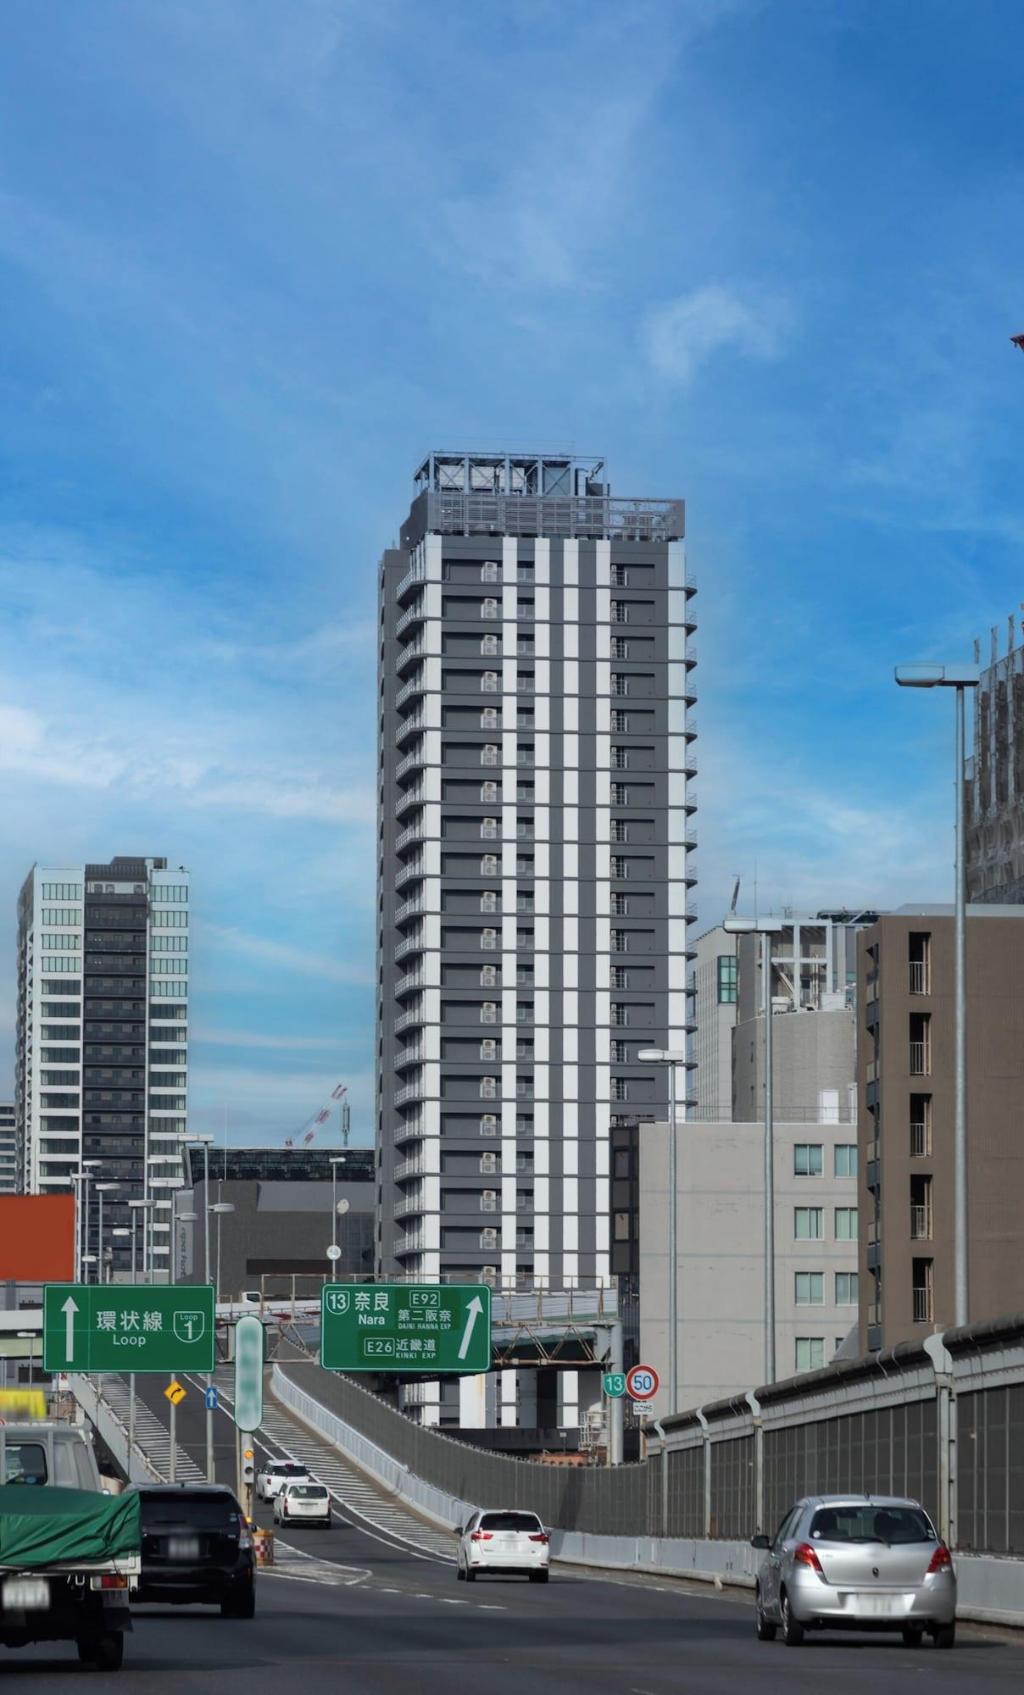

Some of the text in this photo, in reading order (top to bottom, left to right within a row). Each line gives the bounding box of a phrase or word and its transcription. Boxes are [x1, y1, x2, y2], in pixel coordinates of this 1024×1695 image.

[329, 1293, 347, 1310] 13
[354, 1291, 390, 1312] 奈良
[412, 1293, 438, 1305] E92
[96, 1310, 163, 1332] 環状線
[179, 1314, 199, 1322] Loop
[358, 1314, 386, 1326] Nara
[398, 1309, 452, 1322] 第二阪奈
[183, 1320, 193, 1340] 1
[112, 1334, 147, 1348] Loop
[367, 1341, 393, 1353] E26
[395, 1338, 436, 1352] 近畿道
[606, 1376, 623, 1391] 13
[633, 1375, 652, 1391] 50
